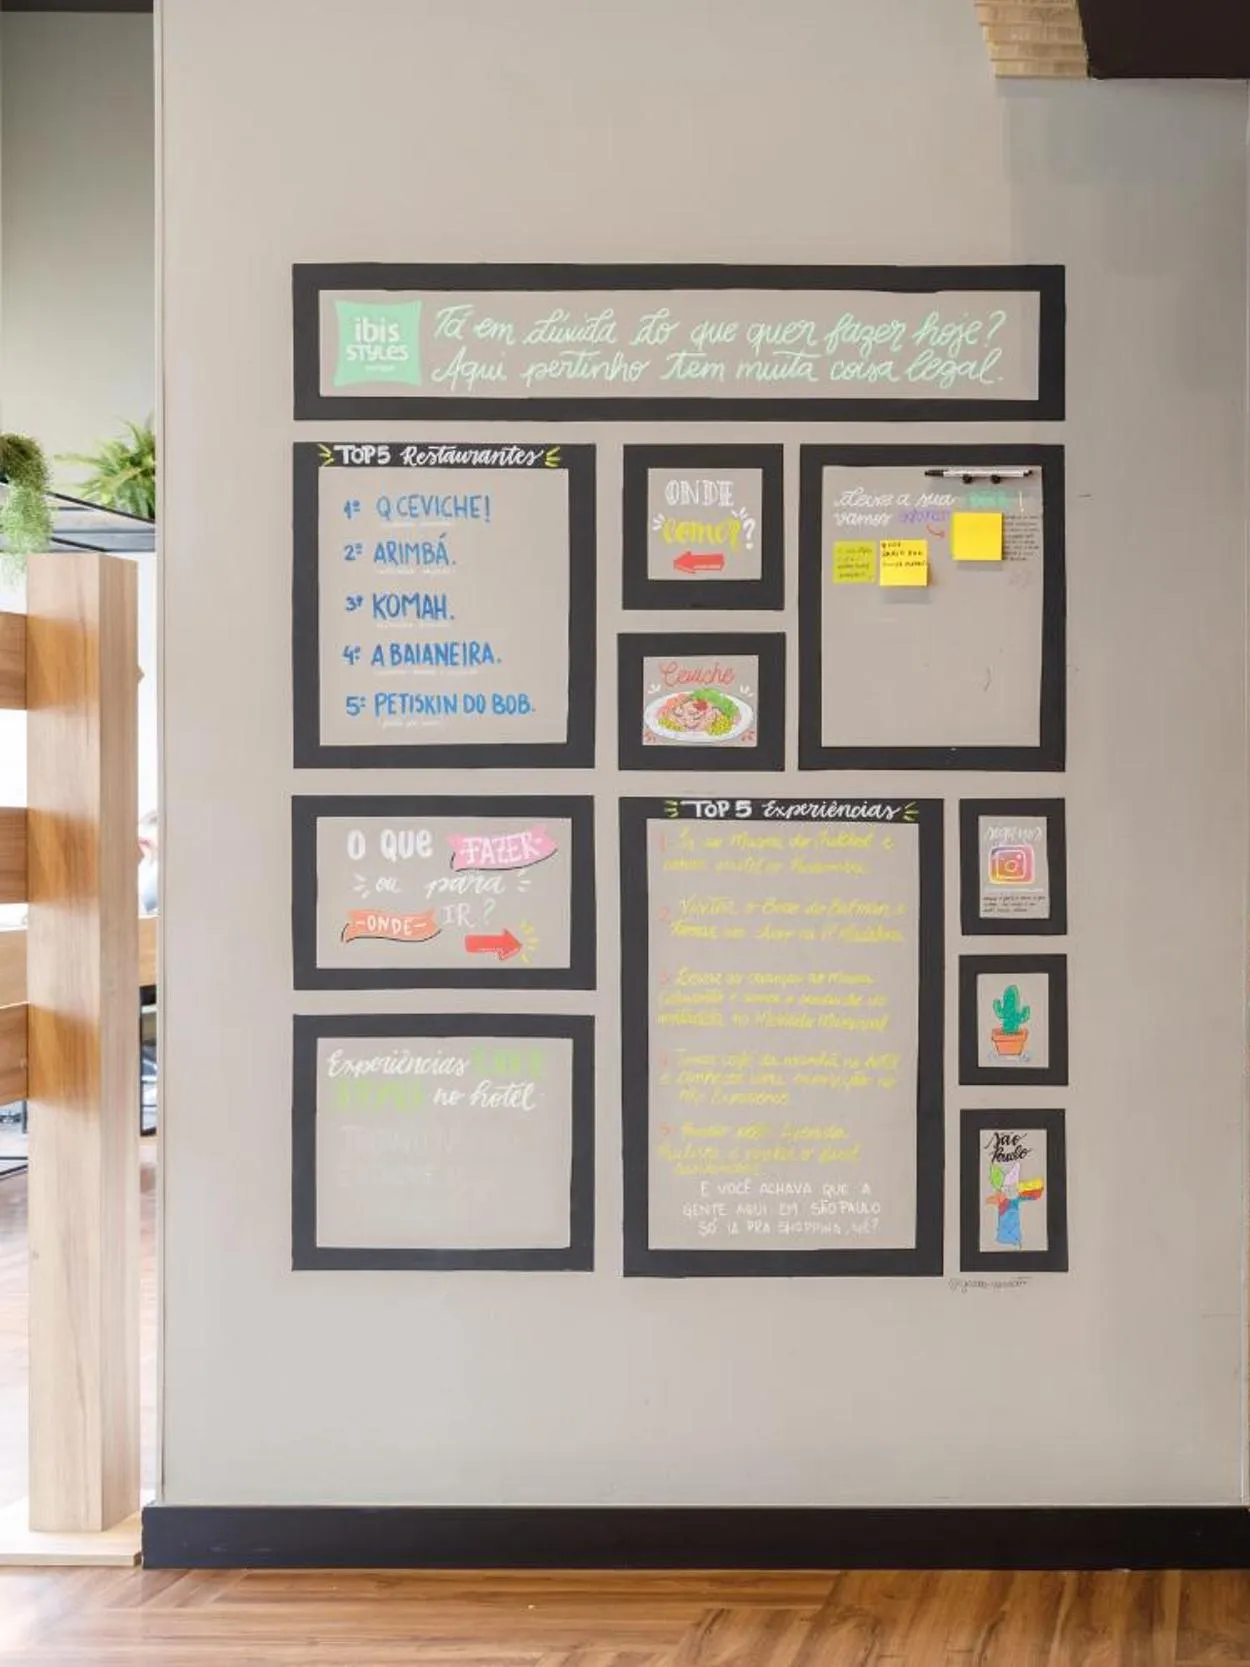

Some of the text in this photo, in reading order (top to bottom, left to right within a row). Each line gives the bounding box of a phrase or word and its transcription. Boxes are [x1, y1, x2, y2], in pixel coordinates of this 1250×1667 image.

[355, 316, 400, 343] ibis
[433, 304, 1006, 358] Tá em dúvida do que quer fazer hoje?
[431, 346, 1004, 392] Aqui pertinho tem muita coisa legal.
[400, 444, 545, 467] Restaurantes
[664, 479, 735, 507] ONDE
[896, 493, 911, 506] a
[915, 491, 956, 508] sua
[397, 494, 491, 523] CEVICHE!
[373, 531, 457, 566] ARIMBÁ.
[373, 592, 455, 620] KOMAH.
[371, 642, 385, 667] A
[390, 640, 502, 667] BAIANEIRA.
[659, 660, 736, 688] Ceviche
[375, 692, 457, 717] PETISKIN
[463, 693, 486, 715] DO
[492, 693, 537, 715] BOB.
[680, 799, 902, 820] TOP 5 Experiências
[347, 829, 366, 861] O
[375, 871, 507, 899] ou para
[328, 1048, 470, 1079] Experiências
[432, 1086, 466, 1107] no
[469, 1079, 538, 1113] hotel
[984, 1130, 1028, 1149] São
[989, 1144, 1031, 1163] Paulo
[717, 1177, 751, 1195] VOCÊ
[759, 1183, 813, 1196] ACHAVA
[823, 1183, 850, 1198] QUE
[861, 1182, 872, 1195] A
[682, 1202, 728, 1218] GENTE
[736, 1203, 767, 1217] AQUI
[811, 1199, 836, 1216] SÃO
[839, 1200, 881, 1215] PAULO
[698, 1218, 718, 1238] SÓ
[747, 1220, 771, 1235] PRA
